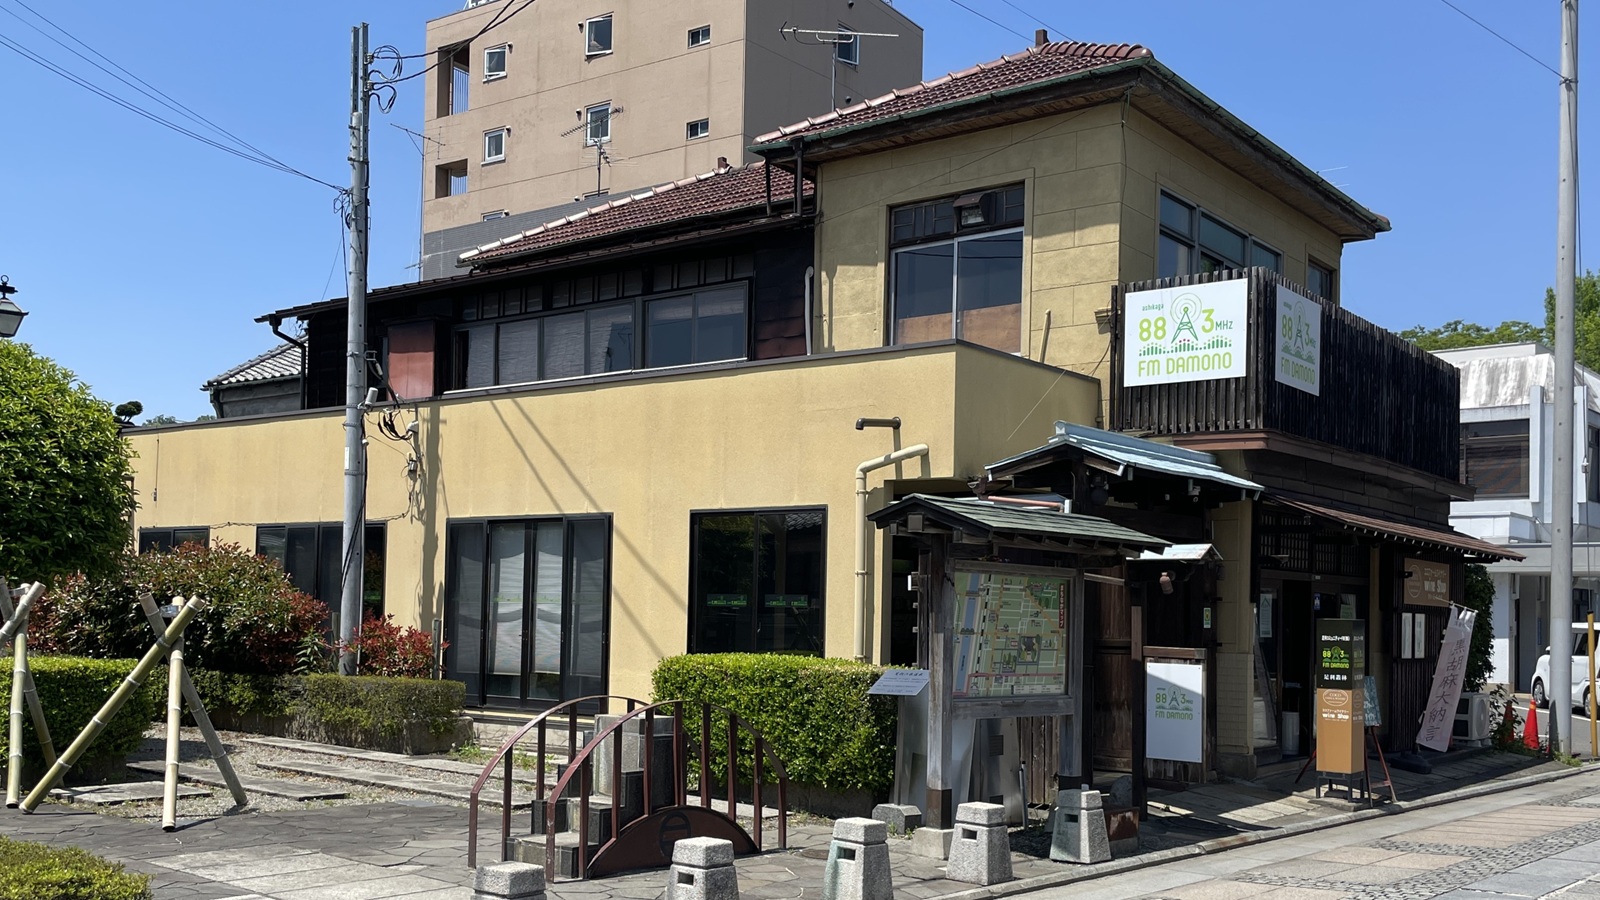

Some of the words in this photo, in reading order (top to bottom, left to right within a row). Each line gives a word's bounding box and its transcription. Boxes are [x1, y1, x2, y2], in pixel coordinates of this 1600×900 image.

[1142, 303, 1164, 312] ashikaga
[1139, 316, 1167, 342] 88
[1201, 308, 1215, 333] 3
[1281, 314, 1293, 340] 88
[1138, 359, 1160, 377] FM
[1166, 352, 1232, 375] DAMONO
[1281, 356, 1290, 376] FM
[1291, 360, 1316, 385] DAMONO
[1322, 650, 1332, 658] 88
[1340, 650, 1345, 658] 3
[1155, 693, 1167, 704] 88
[1180, 694, 1186, 704] 3
[1425, 638, 1465, 742] 黒胡麻大納言
[1155, 710, 1165, 718] FM
[1166, 711, 1193, 720] DAMONO
